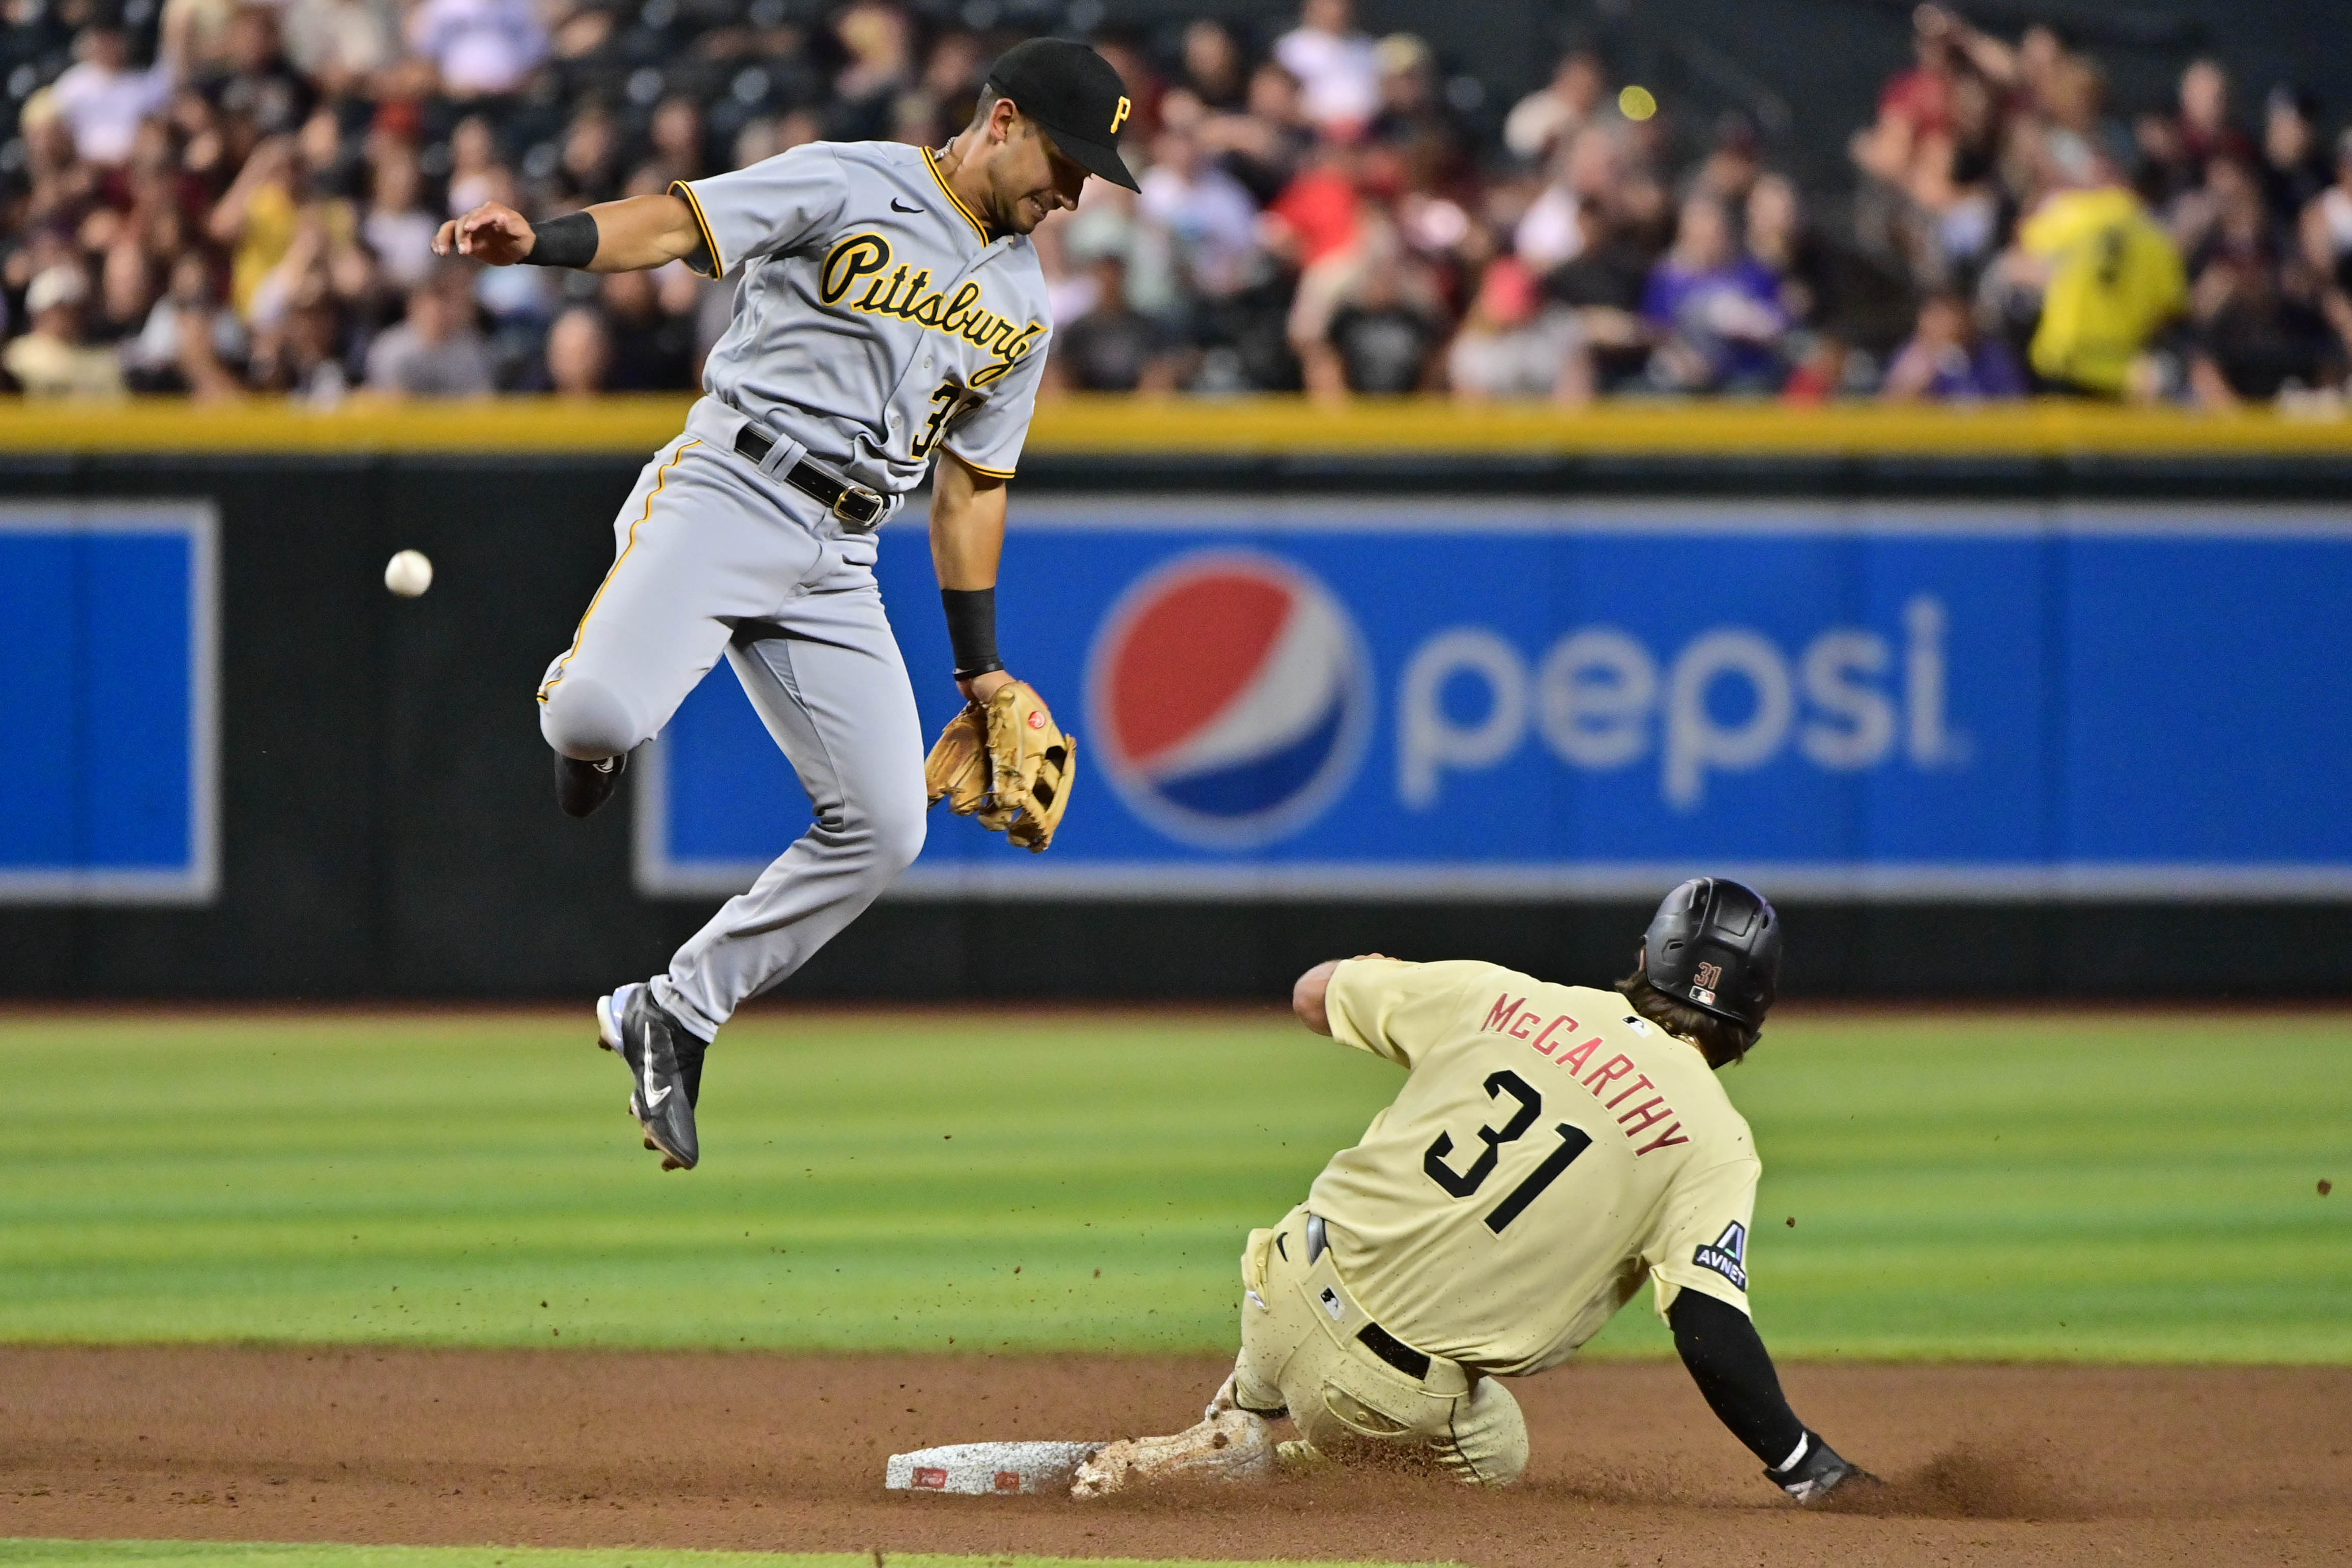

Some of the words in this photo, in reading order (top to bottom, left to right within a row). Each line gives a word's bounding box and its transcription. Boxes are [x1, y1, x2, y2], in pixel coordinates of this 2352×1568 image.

[1110, 96, 1131, 134] P
[819, 231, 1049, 390] Pittsburg
[1398, 596, 1948, 810] pepsi
[1693, 962, 1722, 990] 31
[1423, 1068, 1593, 1236] 31
[1479, 992, 1690, 1158] McCARTHY
[1696, 1249, 1746, 1286] AVNET
